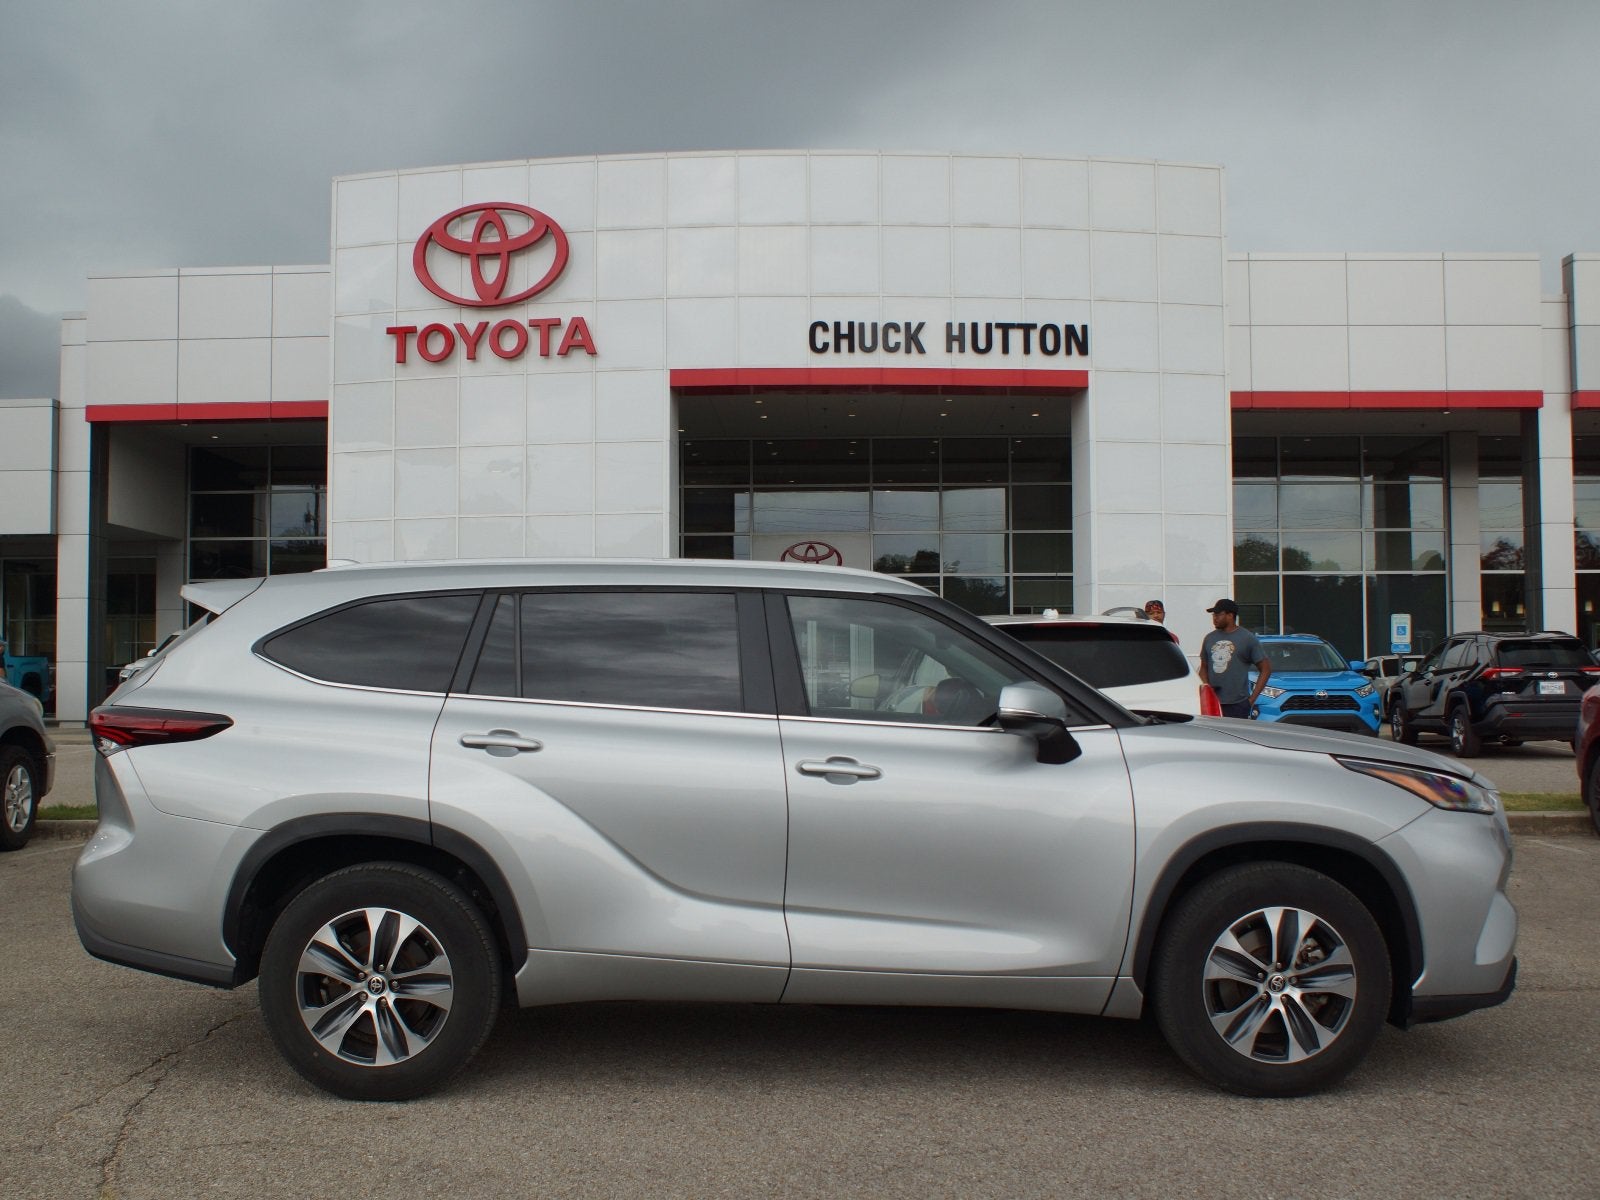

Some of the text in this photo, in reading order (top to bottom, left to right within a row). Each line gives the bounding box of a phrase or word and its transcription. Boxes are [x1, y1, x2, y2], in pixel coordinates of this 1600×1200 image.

[386, 317, 597, 363] TOYOTA
[809, 321, 1089, 356] CHUCK HUTTON
